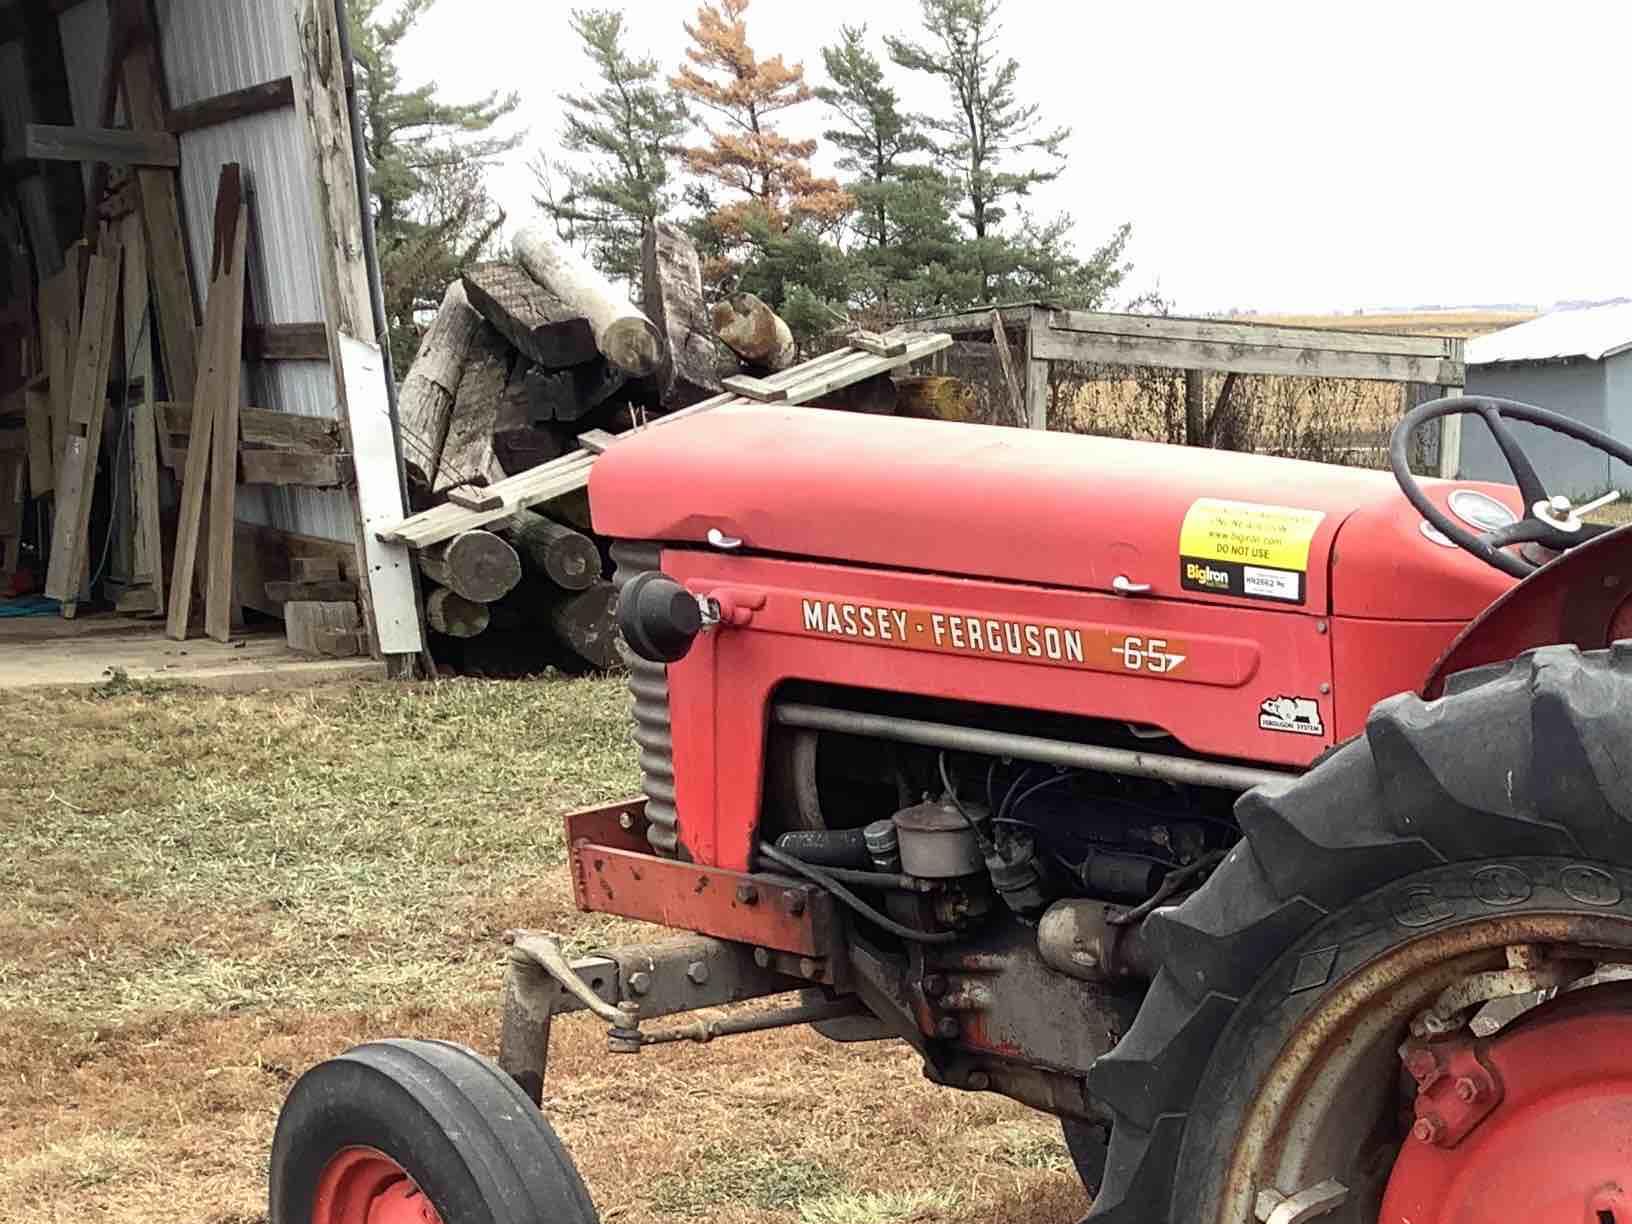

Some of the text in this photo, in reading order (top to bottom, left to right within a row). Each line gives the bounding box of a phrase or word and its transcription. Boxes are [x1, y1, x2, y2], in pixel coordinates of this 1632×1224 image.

[1216, 543, 1270, 560] DO NOT USE
[1186, 564, 1229, 584] BigIron
[802, 600, 907, 641] MASSEY
[932, 615, 1084, 663] FERGUSON
